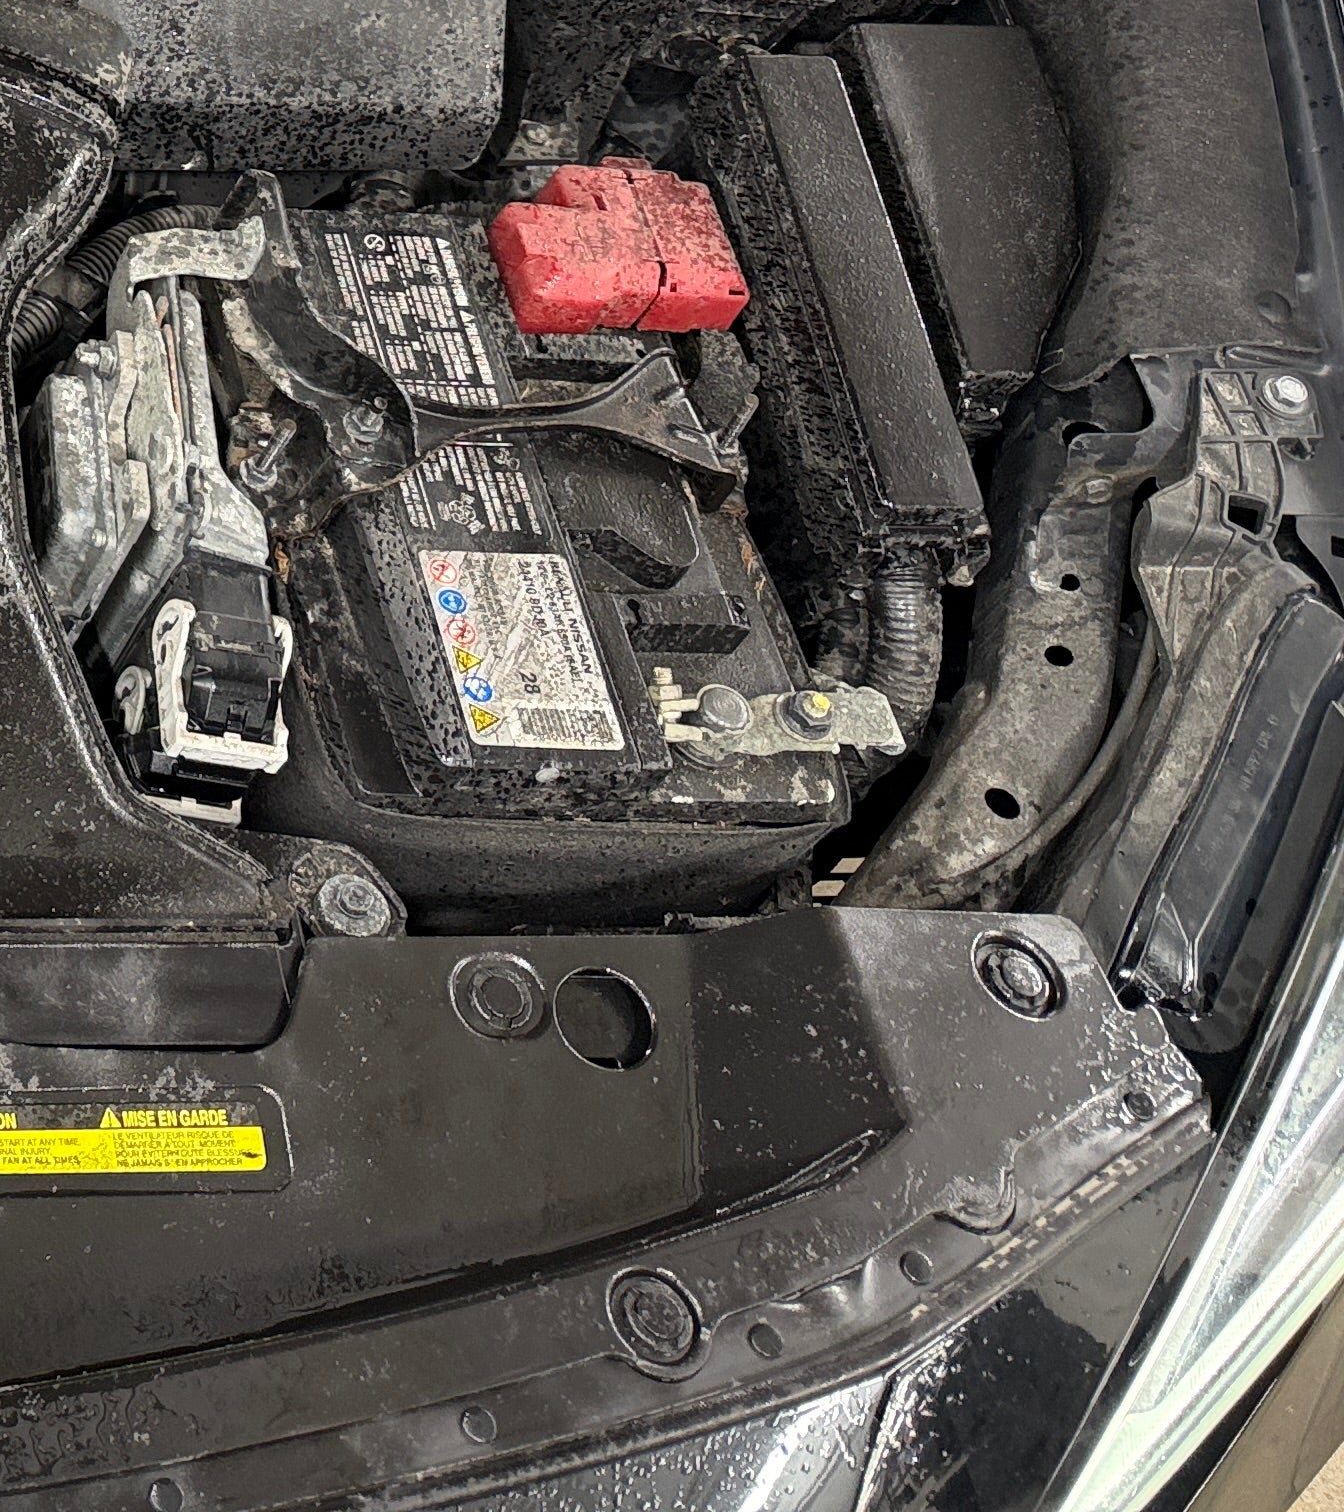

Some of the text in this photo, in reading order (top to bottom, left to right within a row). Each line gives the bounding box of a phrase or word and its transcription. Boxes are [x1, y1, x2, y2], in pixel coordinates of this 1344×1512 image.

[568, 618, 593, 674] NISSAN
[519, 672, 541, 694] 28
[122, 1109, 228, 1127] MISE EN GARDE
[27, 1138, 37, 1146] AT
[39, 1138, 56, 1146] ANY
[187, 1131, 219, 1139] RISQUE
